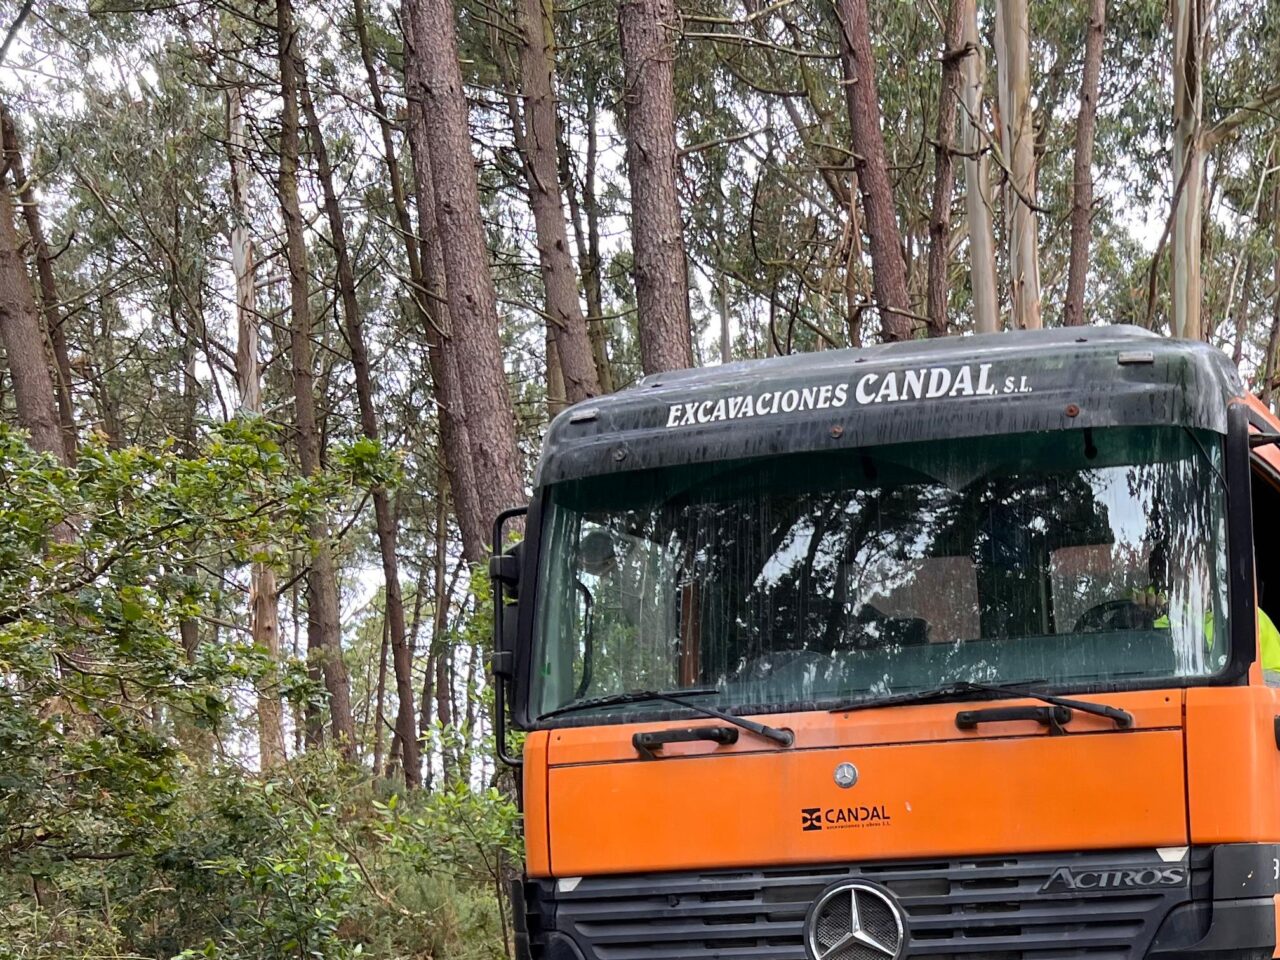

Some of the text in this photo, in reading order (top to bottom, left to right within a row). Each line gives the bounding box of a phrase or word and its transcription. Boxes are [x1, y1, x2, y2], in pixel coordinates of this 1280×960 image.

[666, 383, 848, 428] EXCAVACIONES
[1003, 376, 1033, 393] S.L.
[825, 805, 890, 823] CANDAL
[1042, 866, 1184, 889] ACTROS
